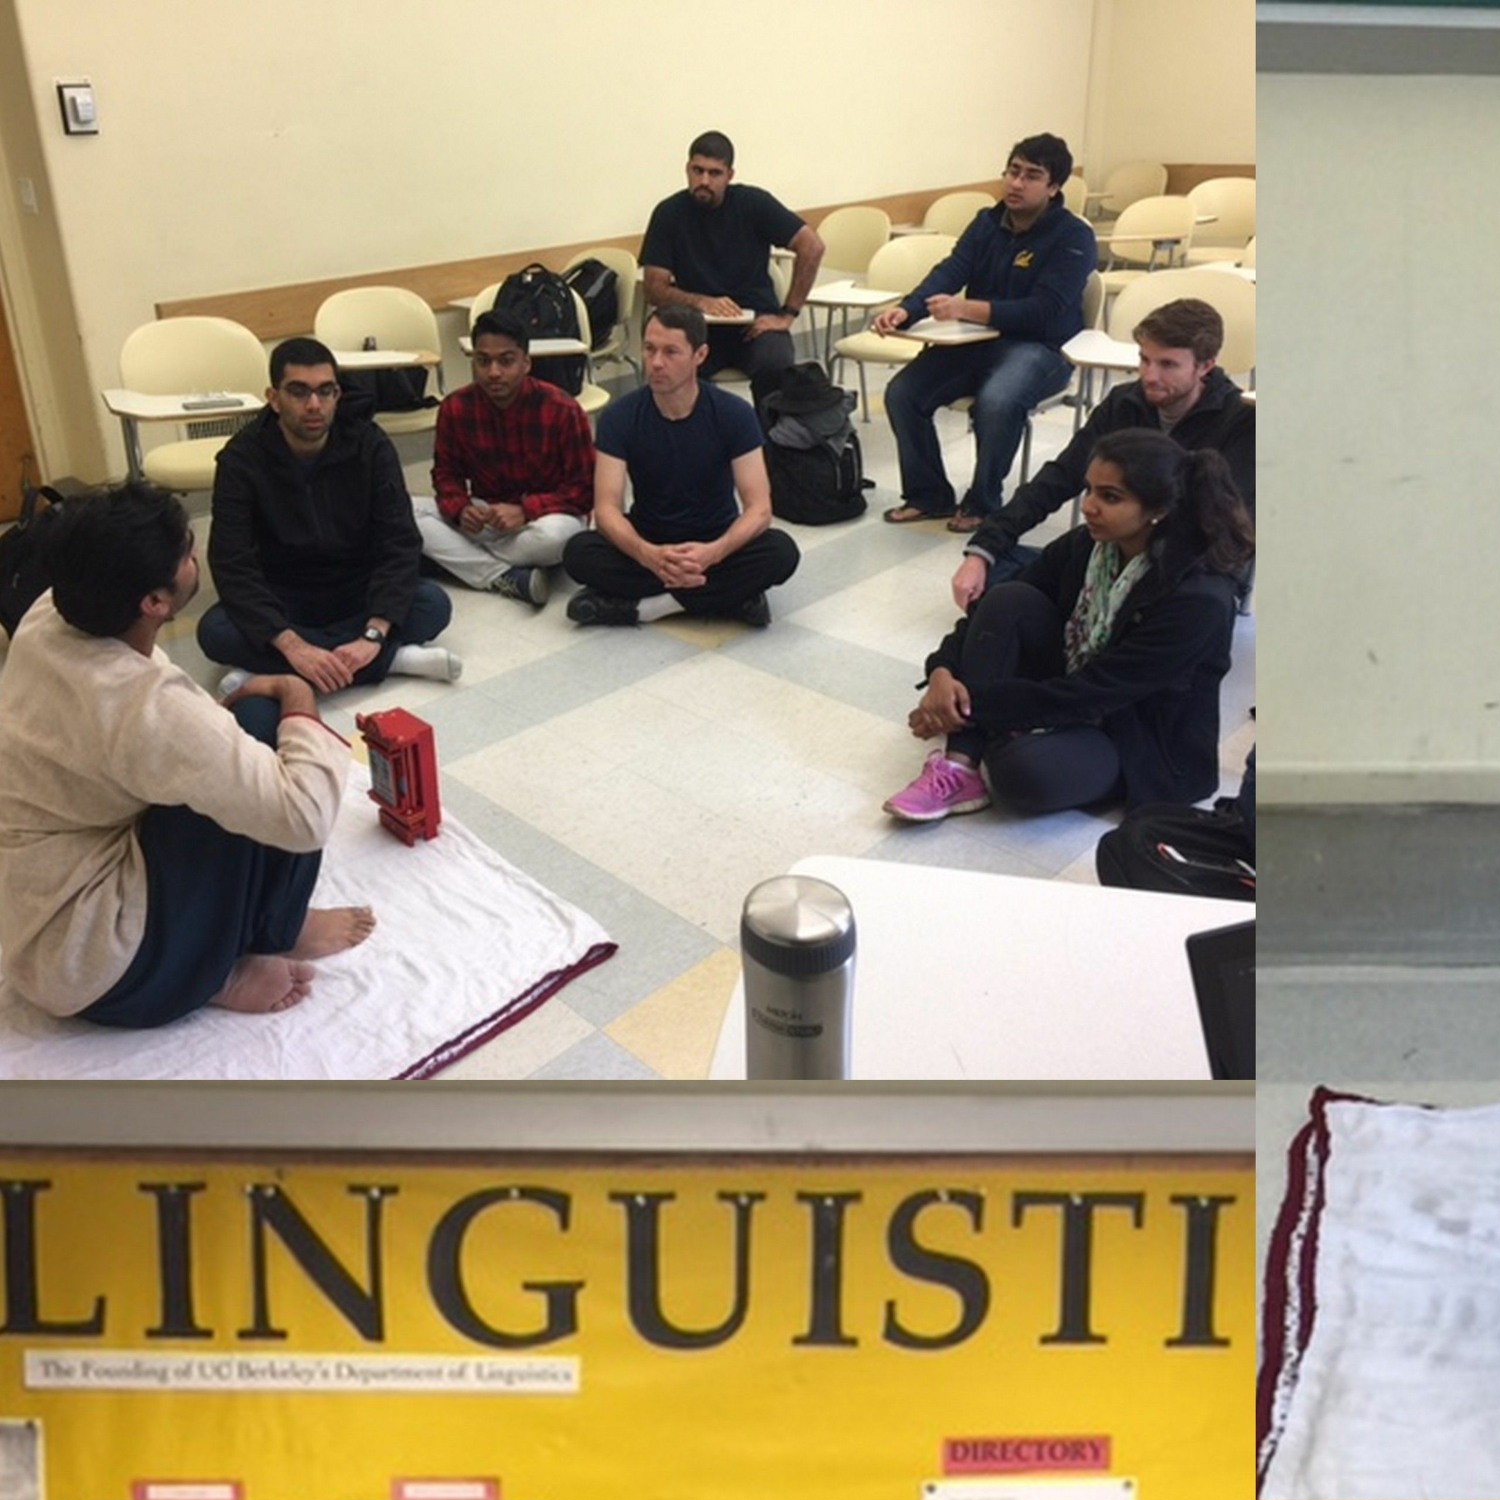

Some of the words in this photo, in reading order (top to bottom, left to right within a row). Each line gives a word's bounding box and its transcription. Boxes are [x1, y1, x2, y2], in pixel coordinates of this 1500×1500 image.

[0, 1178, 1236, 1350] LINGUISTI
[41, 1360, 76, 1379] The
[81, 1361, 168, 1384] Founding
[173, 1360, 194, 1380] of
[199, 1362, 232, 1380] UC
[238, 1361, 329, 1384] Berkeley's
[335, 1363, 443, 1384] Department
[448, 1362, 467, 1380] of
[476, 1363, 573, 1384] Linguistics
[950, 1440, 1102, 1463] DIRECTORY
